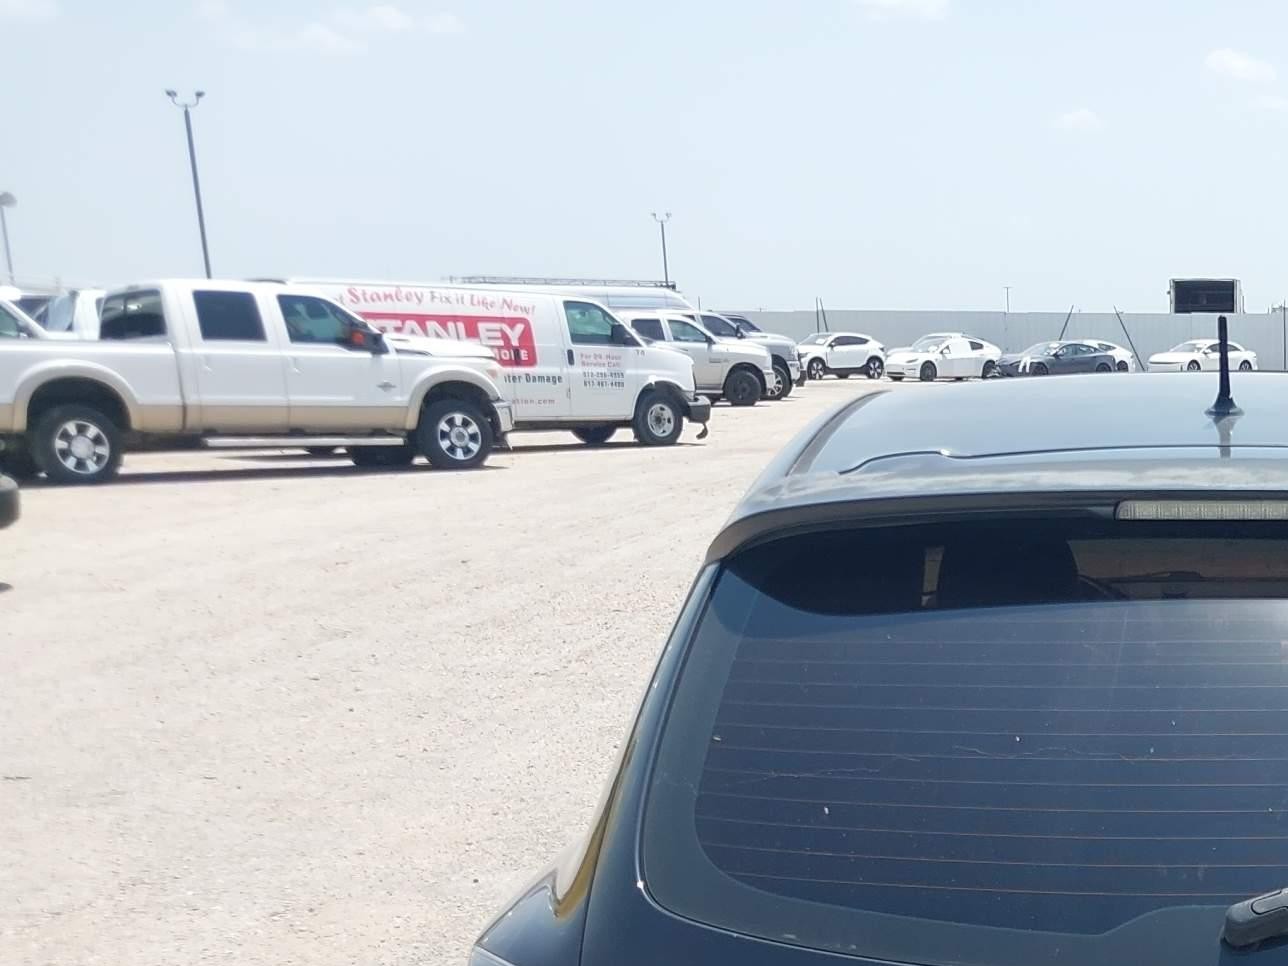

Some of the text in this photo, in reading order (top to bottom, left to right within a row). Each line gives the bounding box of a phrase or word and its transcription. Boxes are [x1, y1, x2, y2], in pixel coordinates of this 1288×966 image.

[347, 286, 424, 306] Stanley
[429, 290, 452, 305] Fix
[469, 294, 497, 312] Like
[502, 297, 536, 316] New!
[525, 373, 563, 386] Damage
